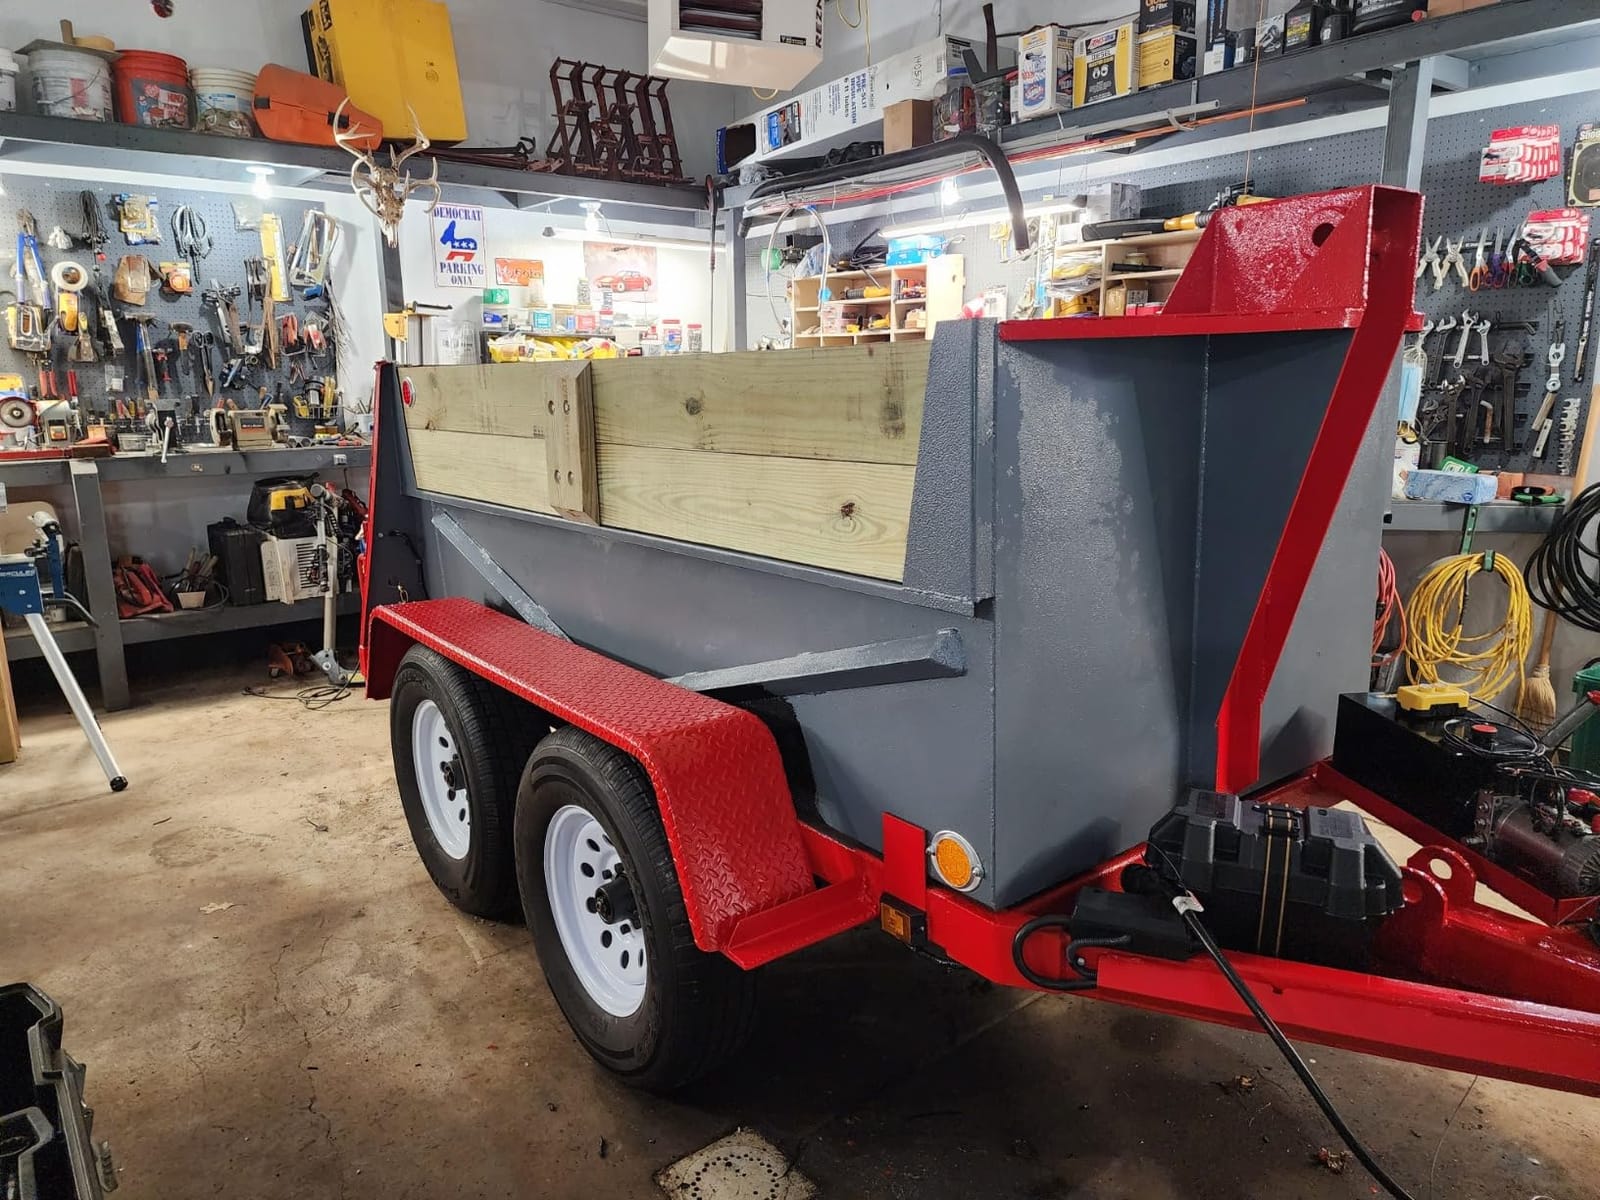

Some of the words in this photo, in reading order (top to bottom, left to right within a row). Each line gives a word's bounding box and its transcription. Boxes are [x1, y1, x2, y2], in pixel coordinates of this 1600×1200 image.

[433, 206, 482, 221] DEMOCRAT
[440, 262, 484, 275] PARKING
[451, 275, 474, 285] ONLY
